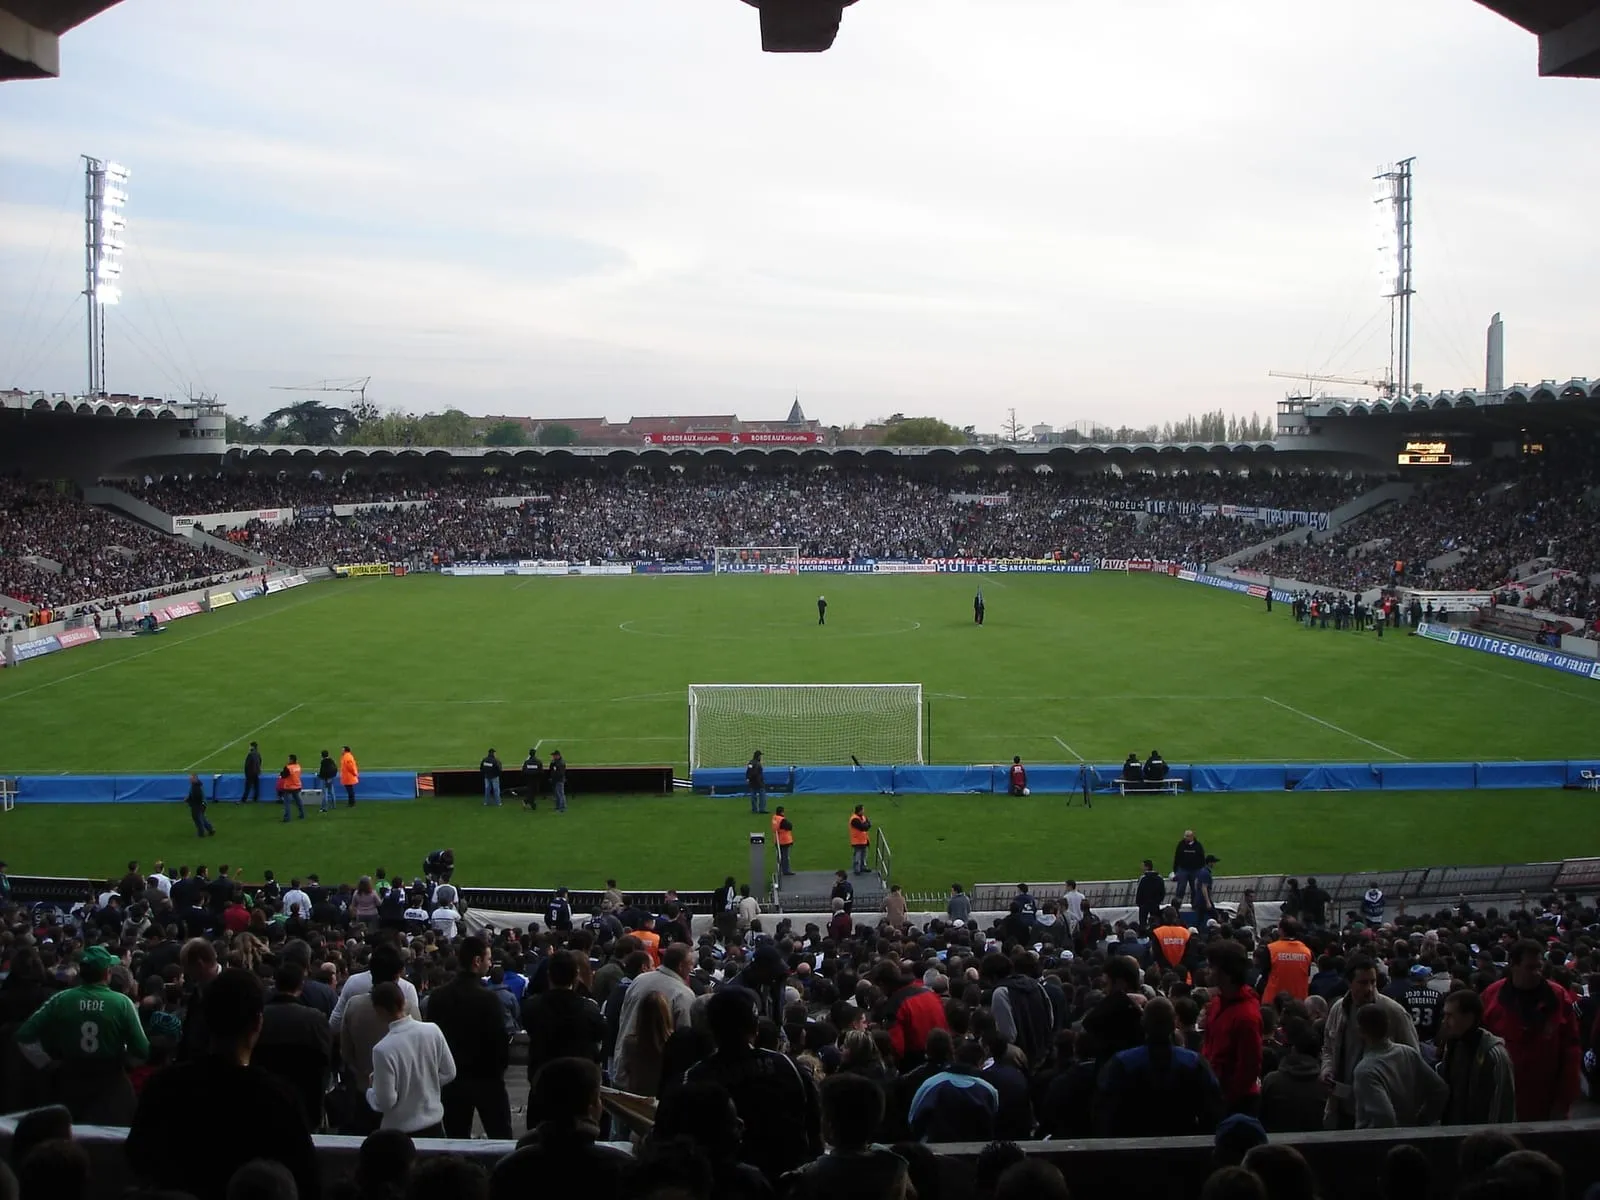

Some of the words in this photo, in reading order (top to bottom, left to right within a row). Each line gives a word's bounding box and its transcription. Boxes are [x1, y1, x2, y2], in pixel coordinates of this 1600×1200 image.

[937, 564, 1008, 572] HUITRES
[1104, 559, 1127, 569] AVIS
[1459, 633, 1518, 657] HUITRES
[1554, 655, 1567, 667] CAP
[1567, 659, 1591, 674] FERRET
[79, 1000, 105, 1012] DEDE
[1411, 1007, 1433, 1026] 33
[80, 1020, 99, 1053] 8
